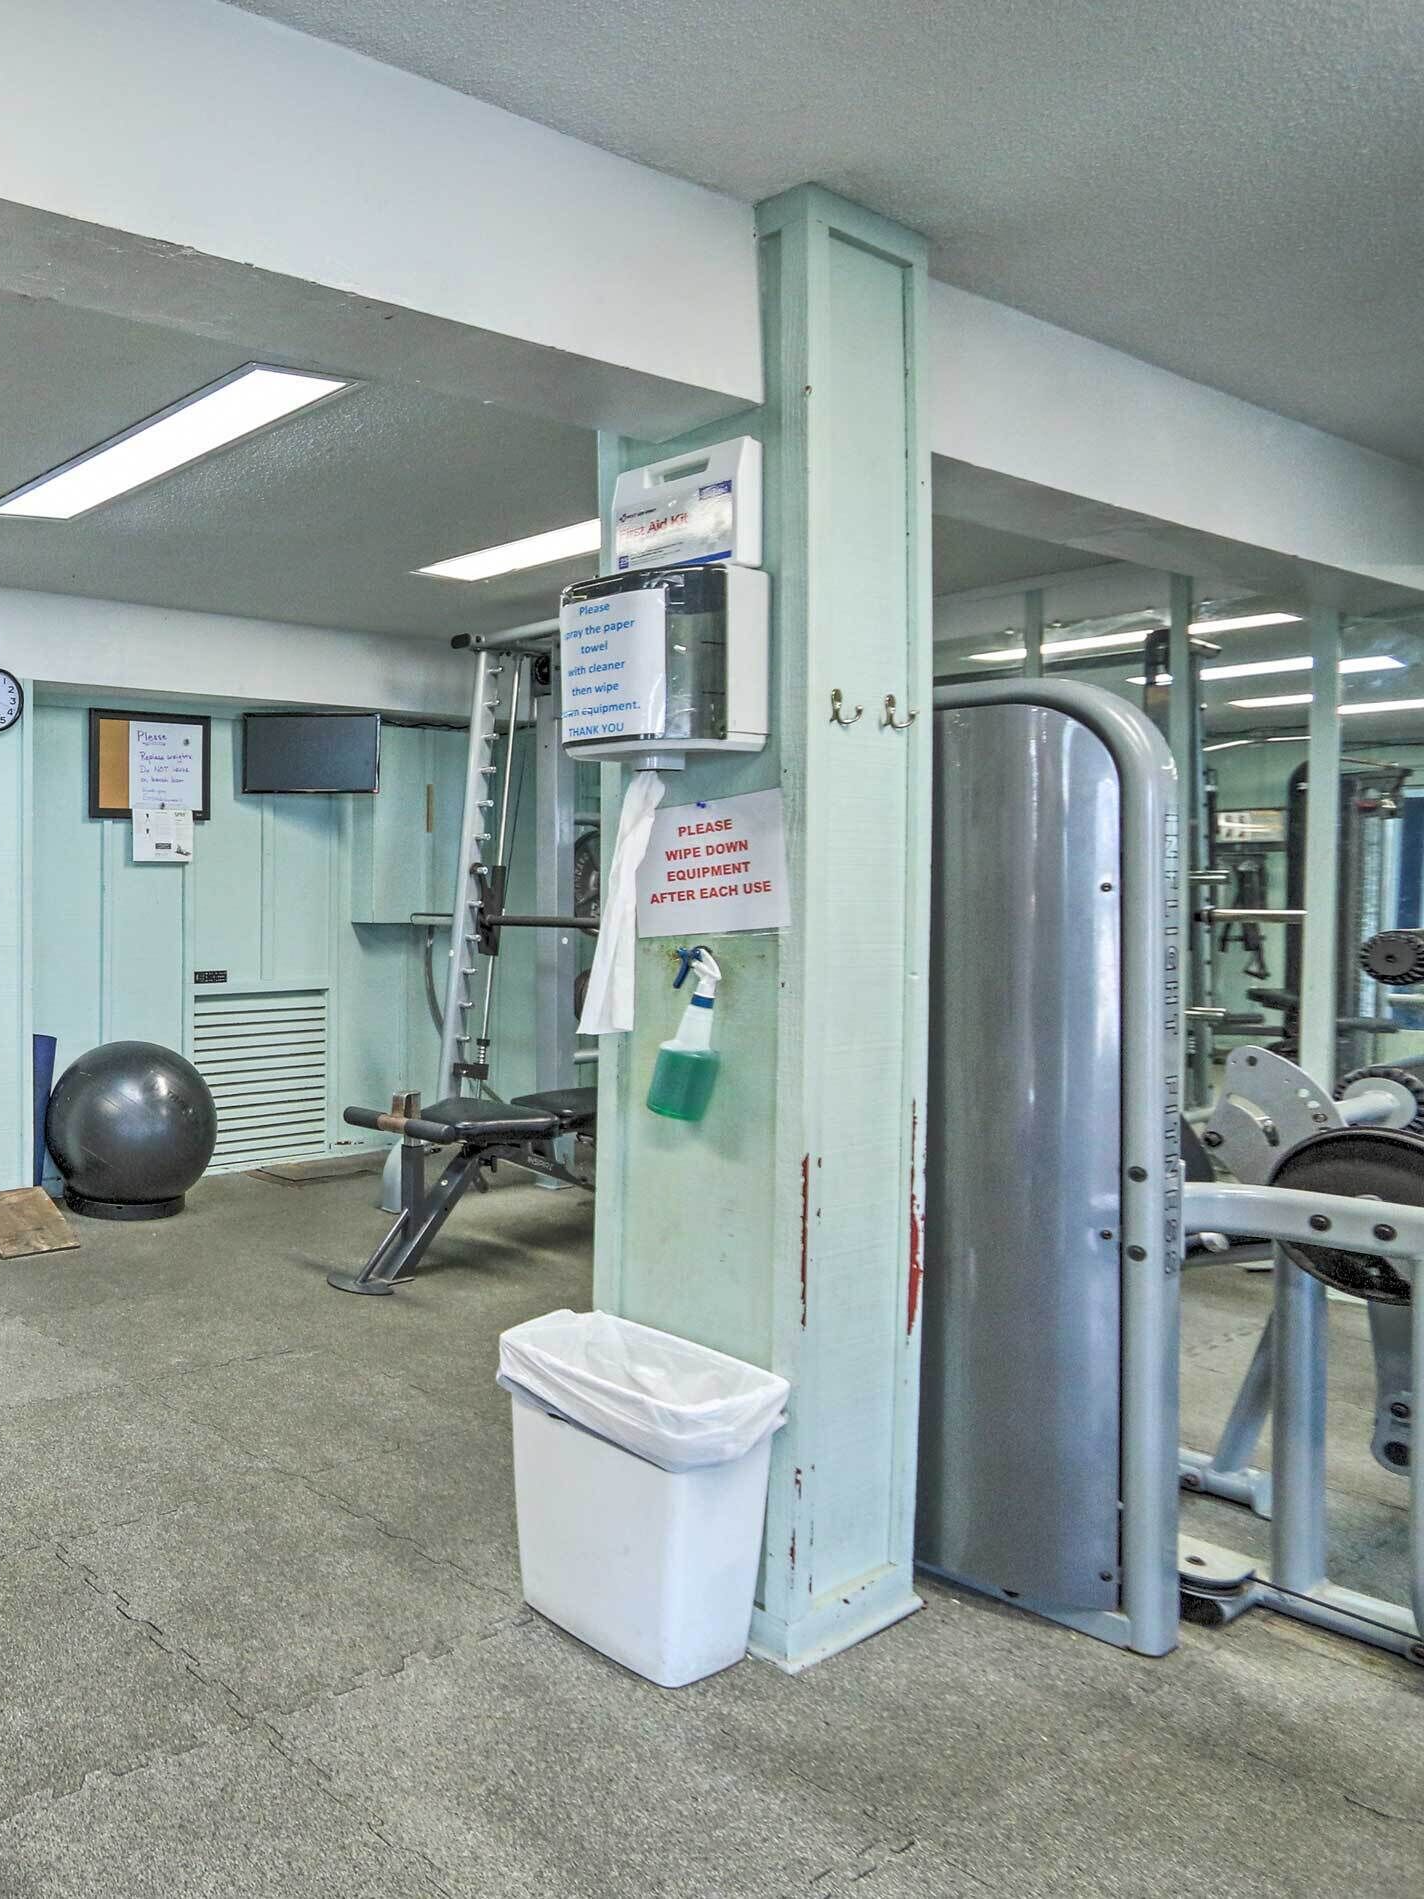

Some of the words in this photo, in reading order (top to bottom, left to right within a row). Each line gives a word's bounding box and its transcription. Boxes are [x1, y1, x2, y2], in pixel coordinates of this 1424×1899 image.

[579, 603, 610, 616] Please
[564, 629, 583, 640] pray
[585, 625, 601, 636] the
[603, 619, 635, 635] paper
[580, 641, 608, 654] towel
[568, 666, 586, 677] with
[588, 660, 625, 673] cleaner
[572, 686, 592, 696] then
[594, 682, 619, 694] wipe
[10, 697, 16, 705] 3
[561, 708, 580, 718] own
[581, 701, 640, 716] equipment.
[137, 730, 168, 742] Please
[569, 724, 599, 736] THANK
[601, 722, 624, 733] YOU
[678, 819, 732, 837] PLEASE
[665, 847, 701, 861] WIPE
[706, 840, 748, 856] DOWN
[667, 861, 750, 881] EQUIPMENT
[650, 889, 695, 904] AFTER
[700, 885, 738, 899] EACH
[743, 881, 772, 894] USE
